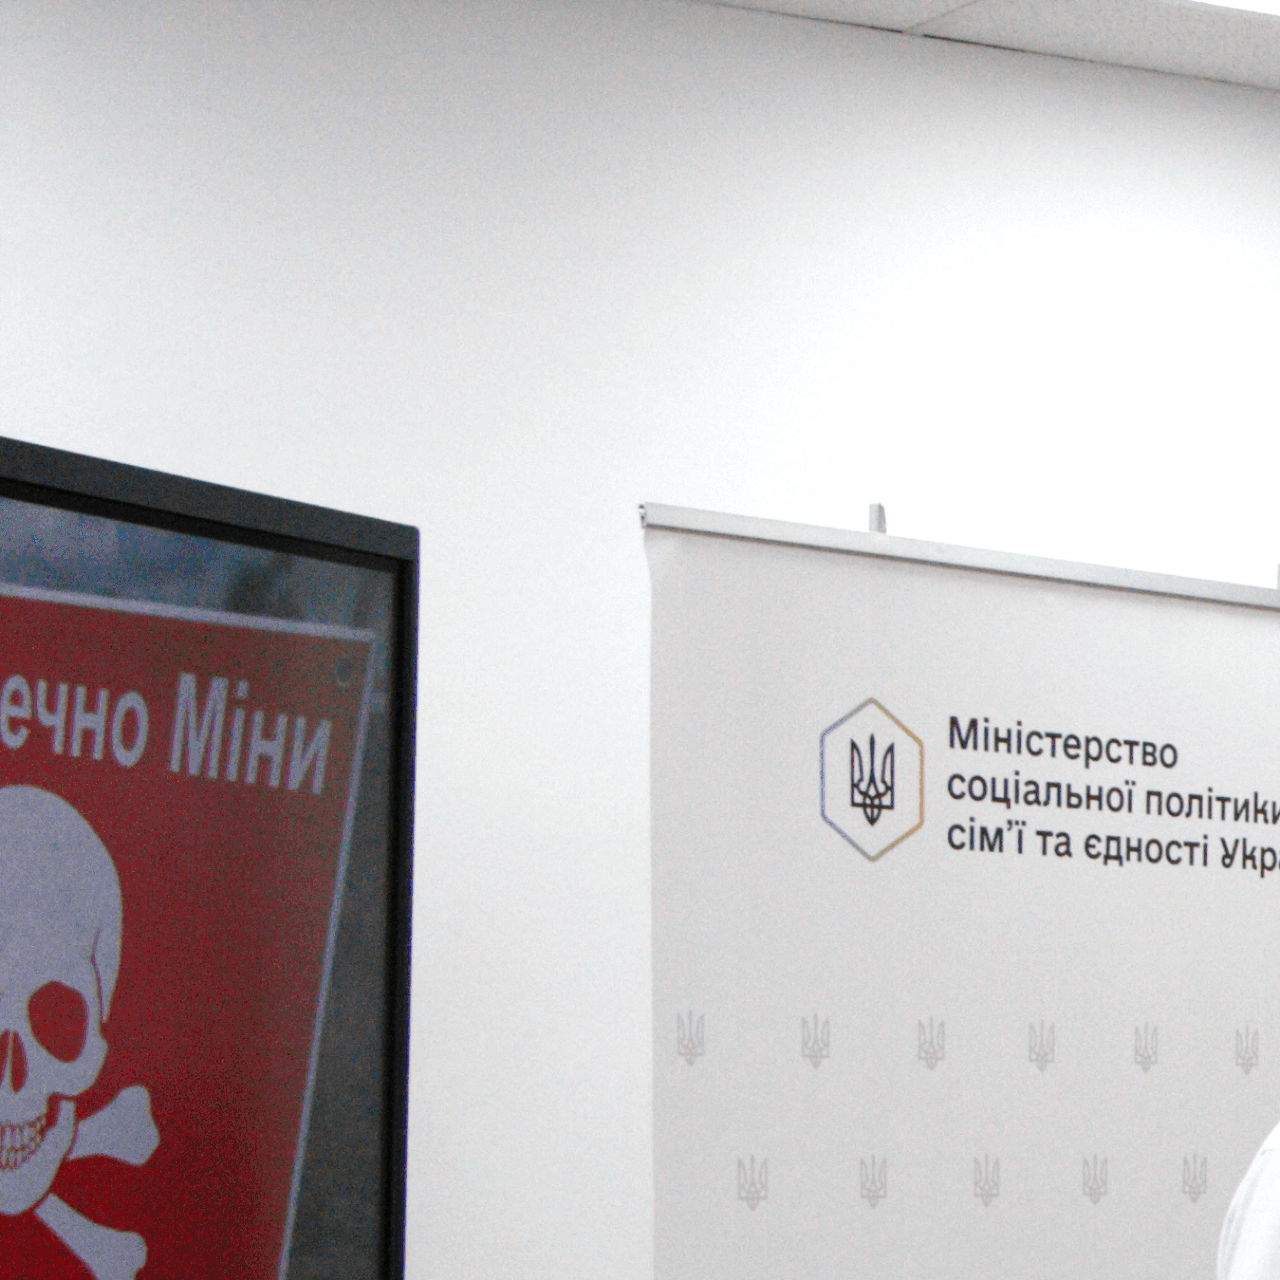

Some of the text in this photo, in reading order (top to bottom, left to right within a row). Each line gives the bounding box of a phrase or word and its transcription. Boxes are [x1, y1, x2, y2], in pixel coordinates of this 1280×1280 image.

[168, 672, 333, 795] Міни
[948, 715, 1178, 769] Міністерство
[947, 771, 1135, 815] соціальної
[1037, 830, 1073, 857] та
[1083, 833, 1208, 868] єдності
